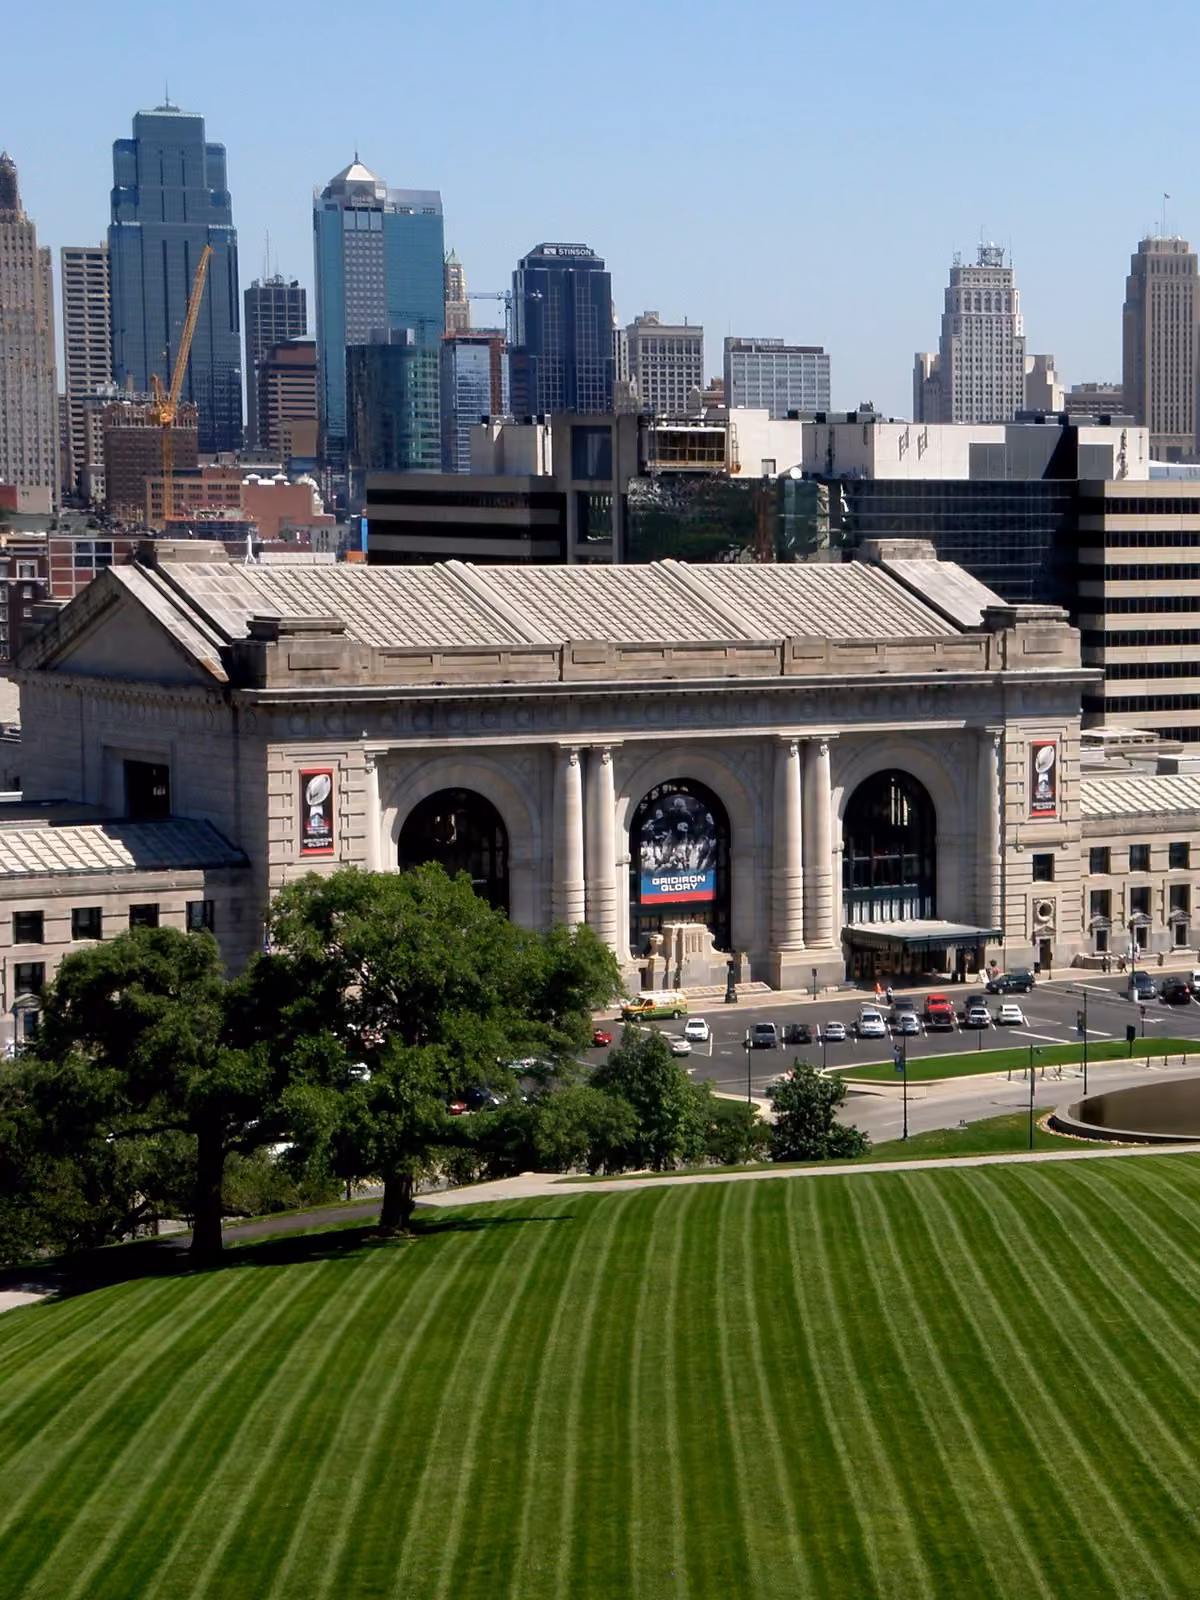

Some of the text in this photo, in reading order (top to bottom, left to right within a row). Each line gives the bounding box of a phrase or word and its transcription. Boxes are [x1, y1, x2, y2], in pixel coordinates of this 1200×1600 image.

[558, 248, 591, 256] STINSON
[117, 391, 182, 401] PRESIDN
[652, 875, 706, 885] GRIDIRON
[660, 882, 698, 892] GLORY
